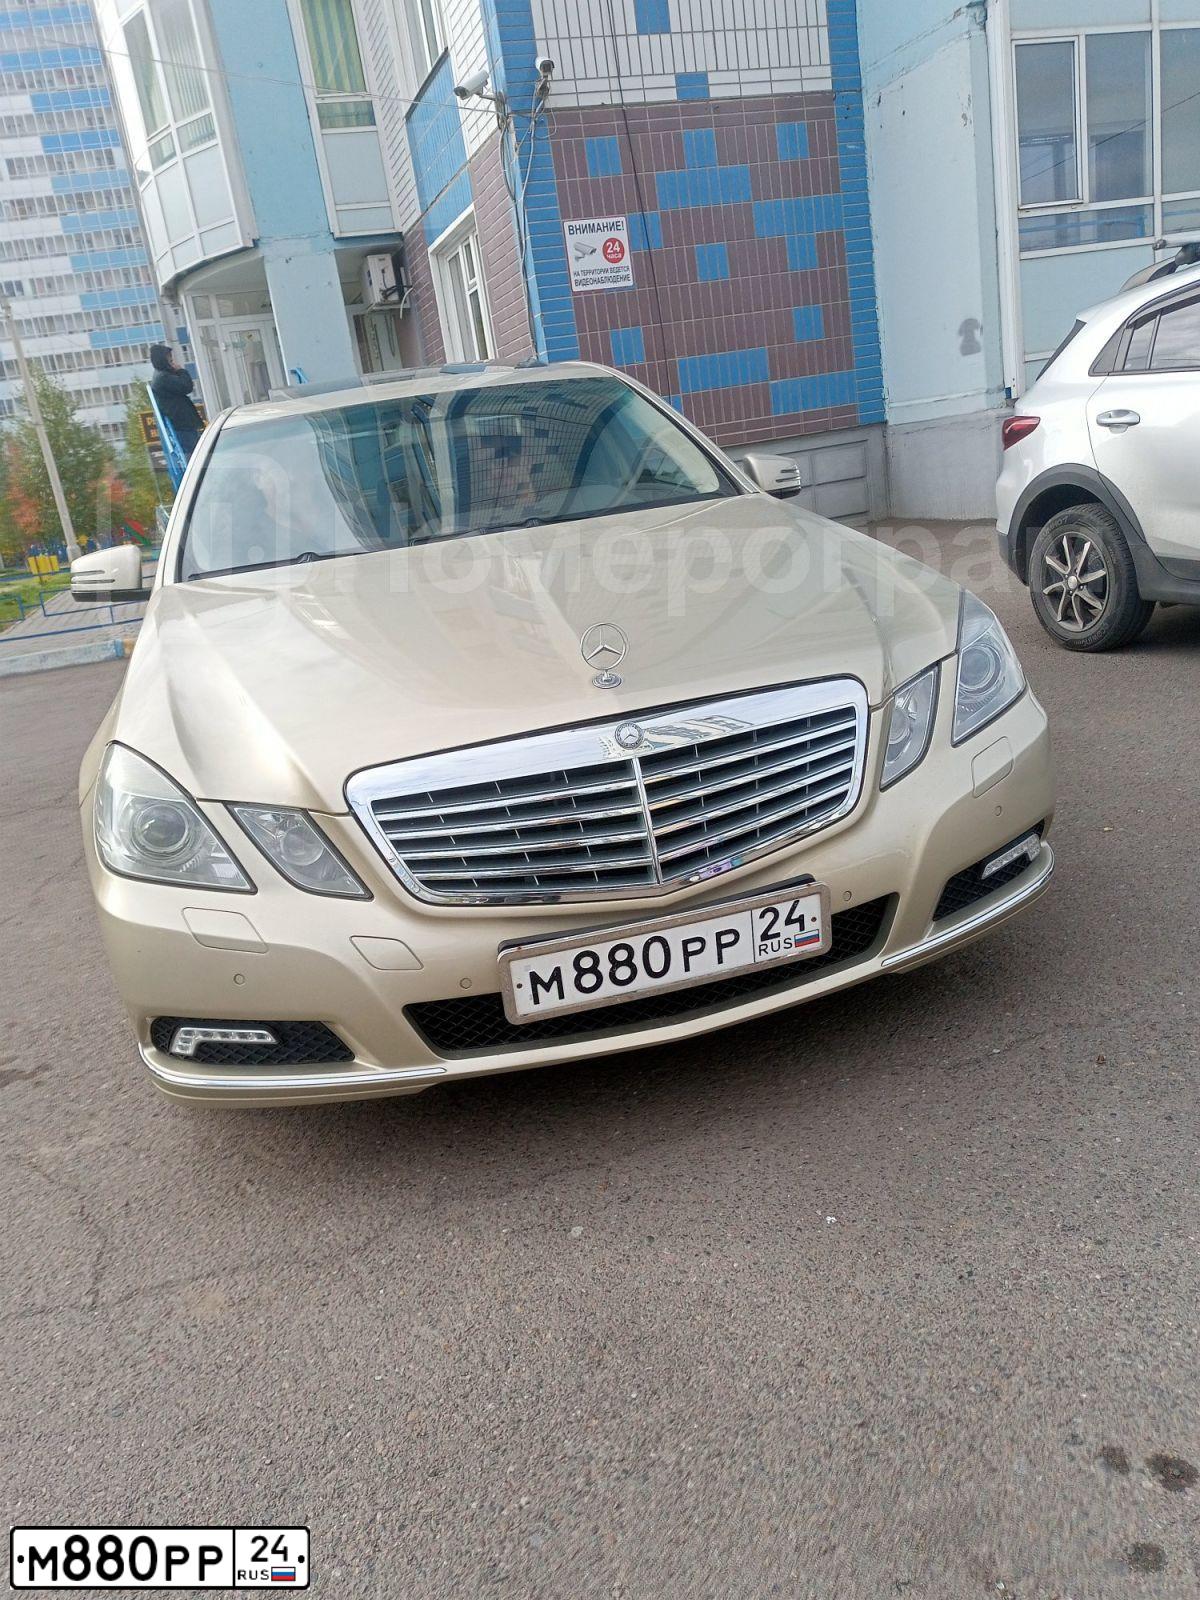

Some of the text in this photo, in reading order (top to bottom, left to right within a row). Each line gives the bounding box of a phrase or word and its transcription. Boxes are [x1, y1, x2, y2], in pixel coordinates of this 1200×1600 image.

[568, 221, 624, 235] ВНИМАНИЕ!
[606, 241, 620, 253] 24
[575, 274, 631, 287] ВИДЕОНАБЛЮДЕНИЕ
[529, 900, 806, 1005] М880РР 24
[758, 938, 793, 956] RUS
